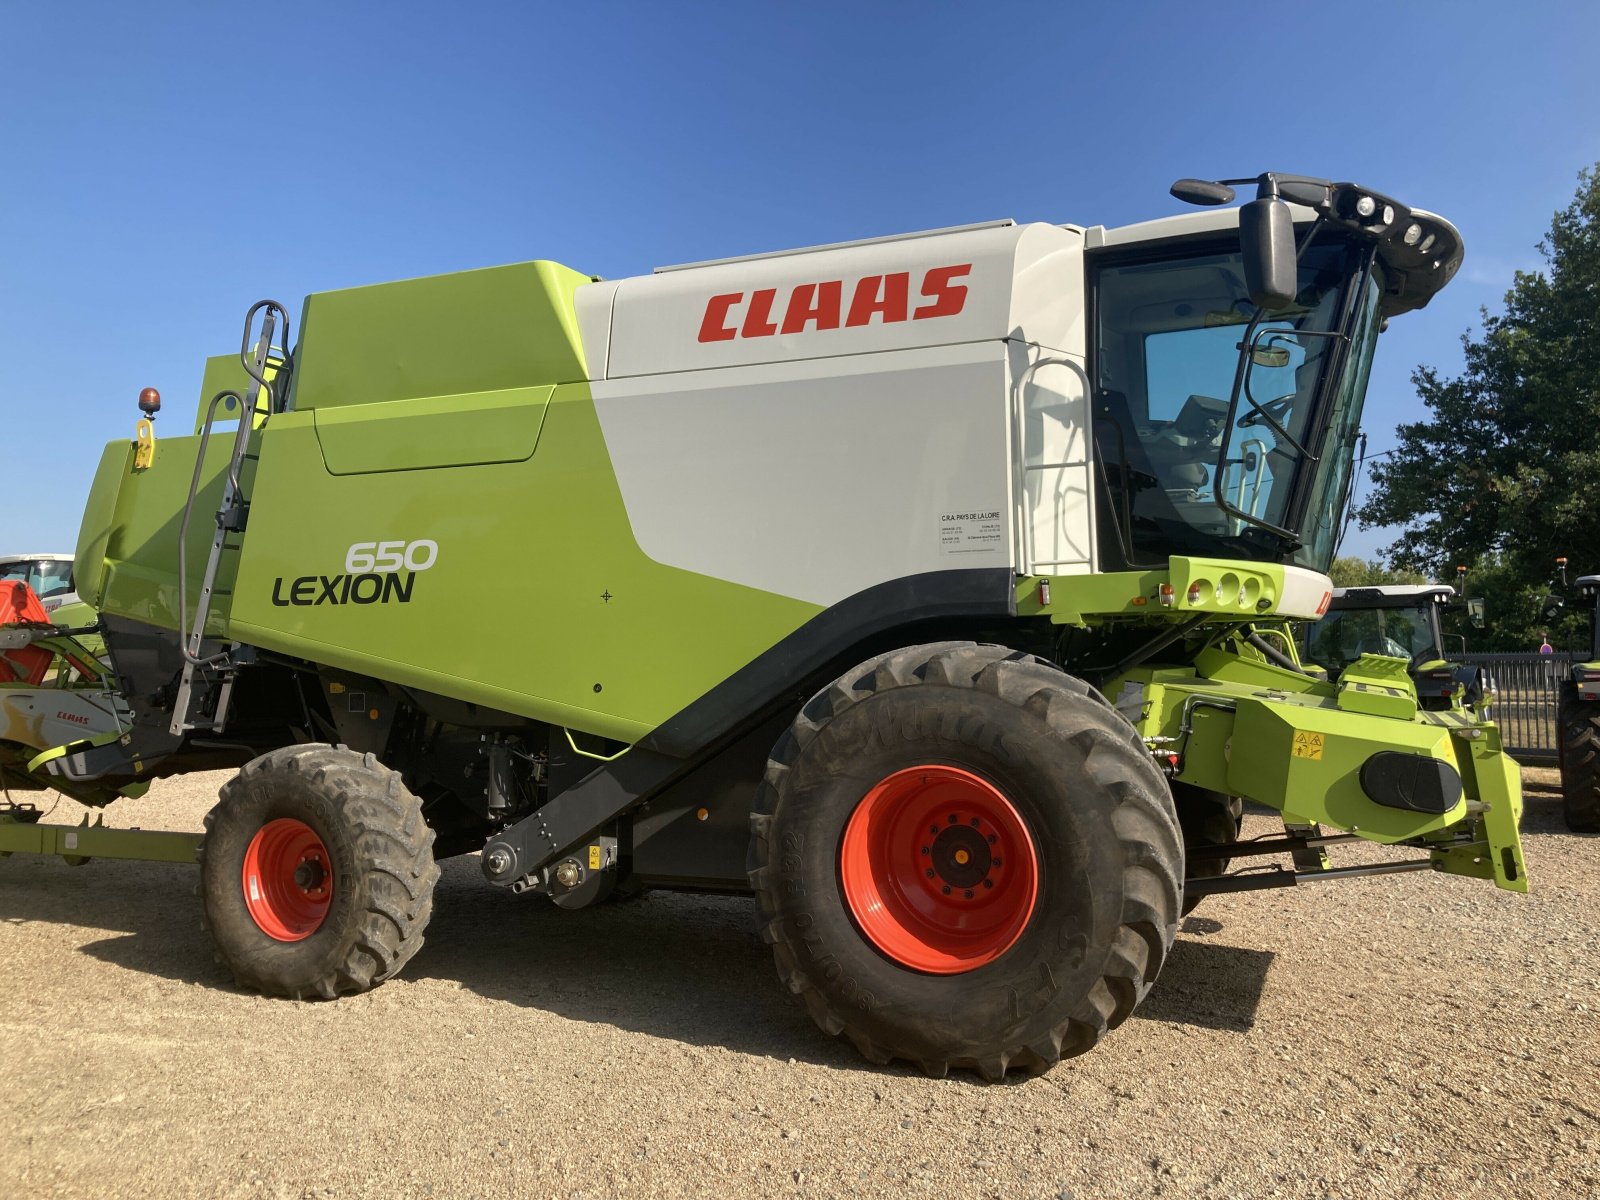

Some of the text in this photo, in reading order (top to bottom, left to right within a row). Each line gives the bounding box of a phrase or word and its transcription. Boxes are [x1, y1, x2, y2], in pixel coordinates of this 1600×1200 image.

[698, 264, 972, 343] CLAAS
[345, 539, 438, 574] 650
[272, 572, 416, 606] LEXION
[56, 711, 90, 725] CLAAS
